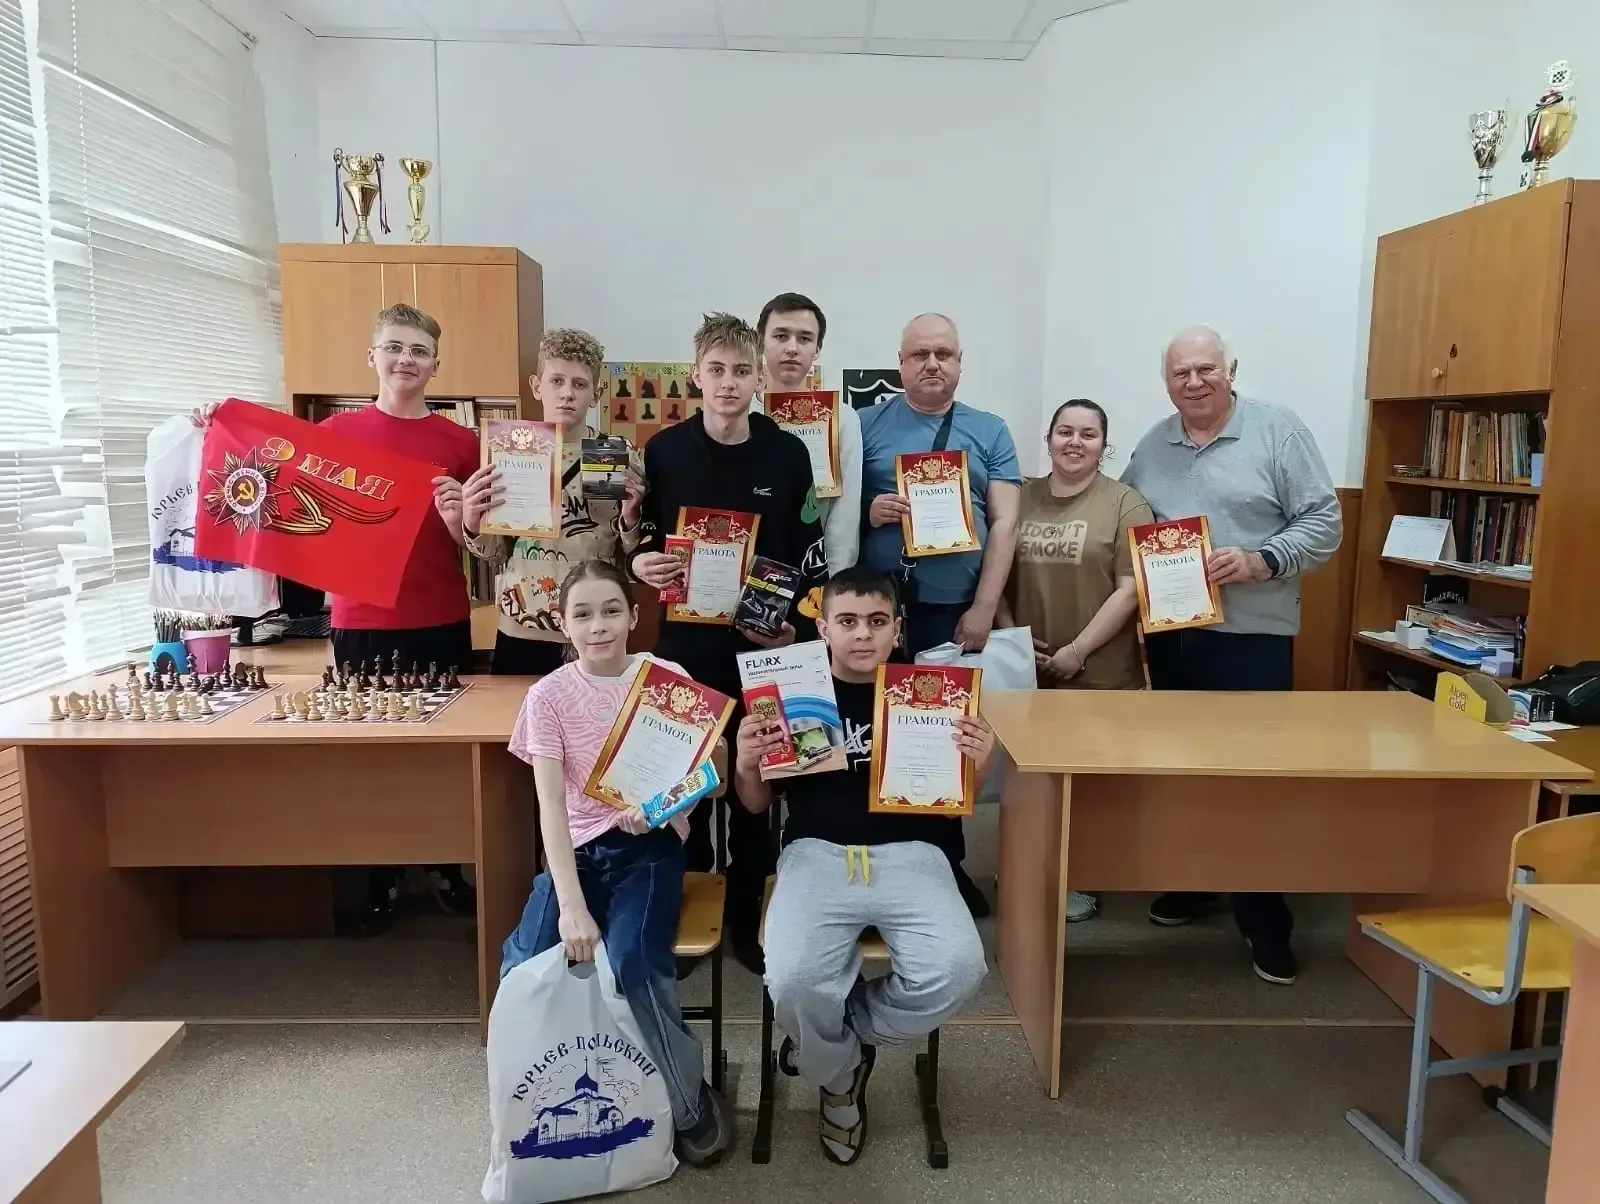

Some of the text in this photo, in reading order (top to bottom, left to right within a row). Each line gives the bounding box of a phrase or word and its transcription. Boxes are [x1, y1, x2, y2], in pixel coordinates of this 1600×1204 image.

[787, 428, 822, 436] РАМОТА
[260, 437, 395, 501] 9 МАЯ
[498, 459, 543, 470] ГРАМОТА
[915, 487, 954, 497] ГРАМОТА
[693, 547, 736, 558] ГРАМОТА
[1020, 541, 1079, 558] SMOKE
[1151, 556, 1196, 569] ГРАМОТА
[745, 656, 781, 669] FLARX
[1449, 684, 1468, 700] Alpen
[753, 701, 776, 711] Alpen
[1449, 697, 1466, 712] Gold
[898, 715, 954, 727] ГРАМОТА
[642, 716, 693, 745] ГРАМОТА
